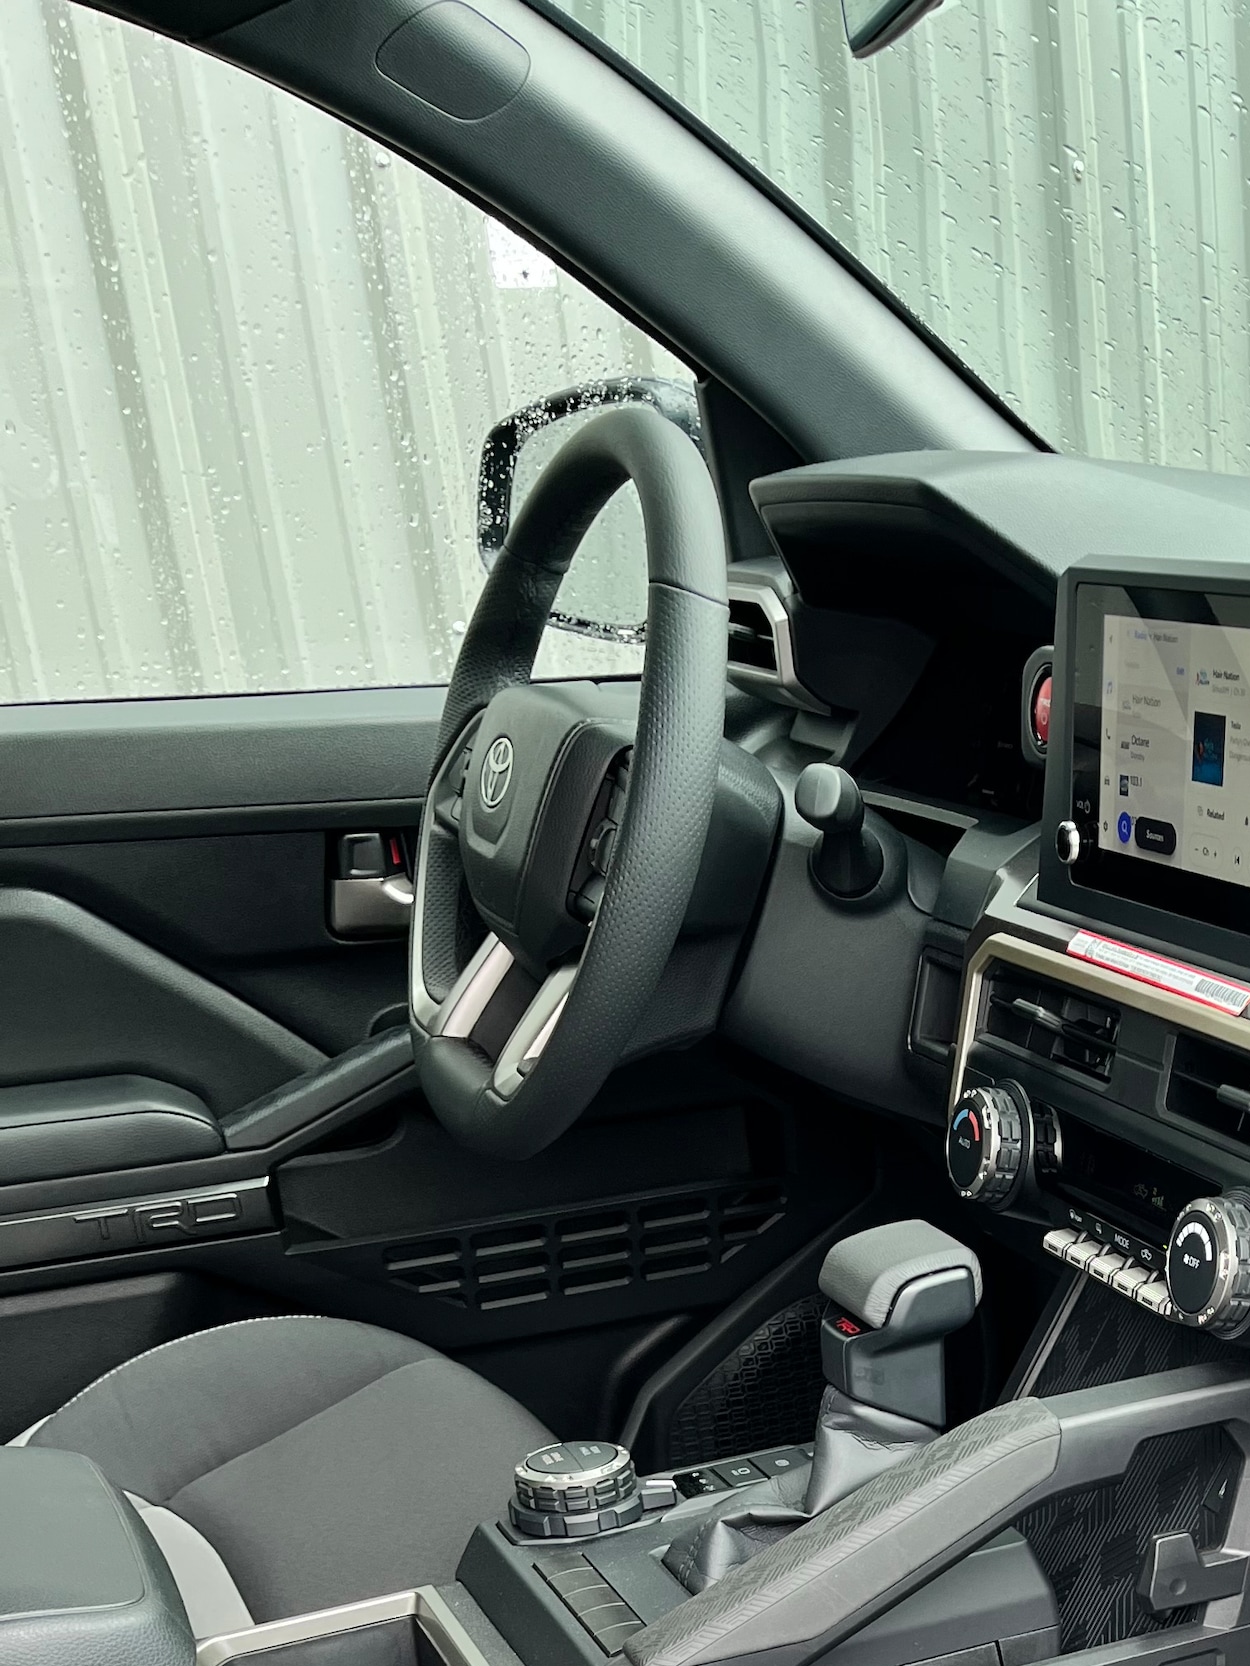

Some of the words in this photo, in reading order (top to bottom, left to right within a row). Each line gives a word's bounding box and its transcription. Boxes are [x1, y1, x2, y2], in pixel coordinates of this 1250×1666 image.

[1212, 669, 1223, 679] Hair
[1223, 671, 1240, 681] Nation
[1131, 734, 1150, 748] Octane
[1207, 808, 1225, 821] Related
[74, 1193, 243, 1243] TRD
[1114, 1233, 1130, 1249] MODE
[1188, 1255, 1201, 1269] OFF
